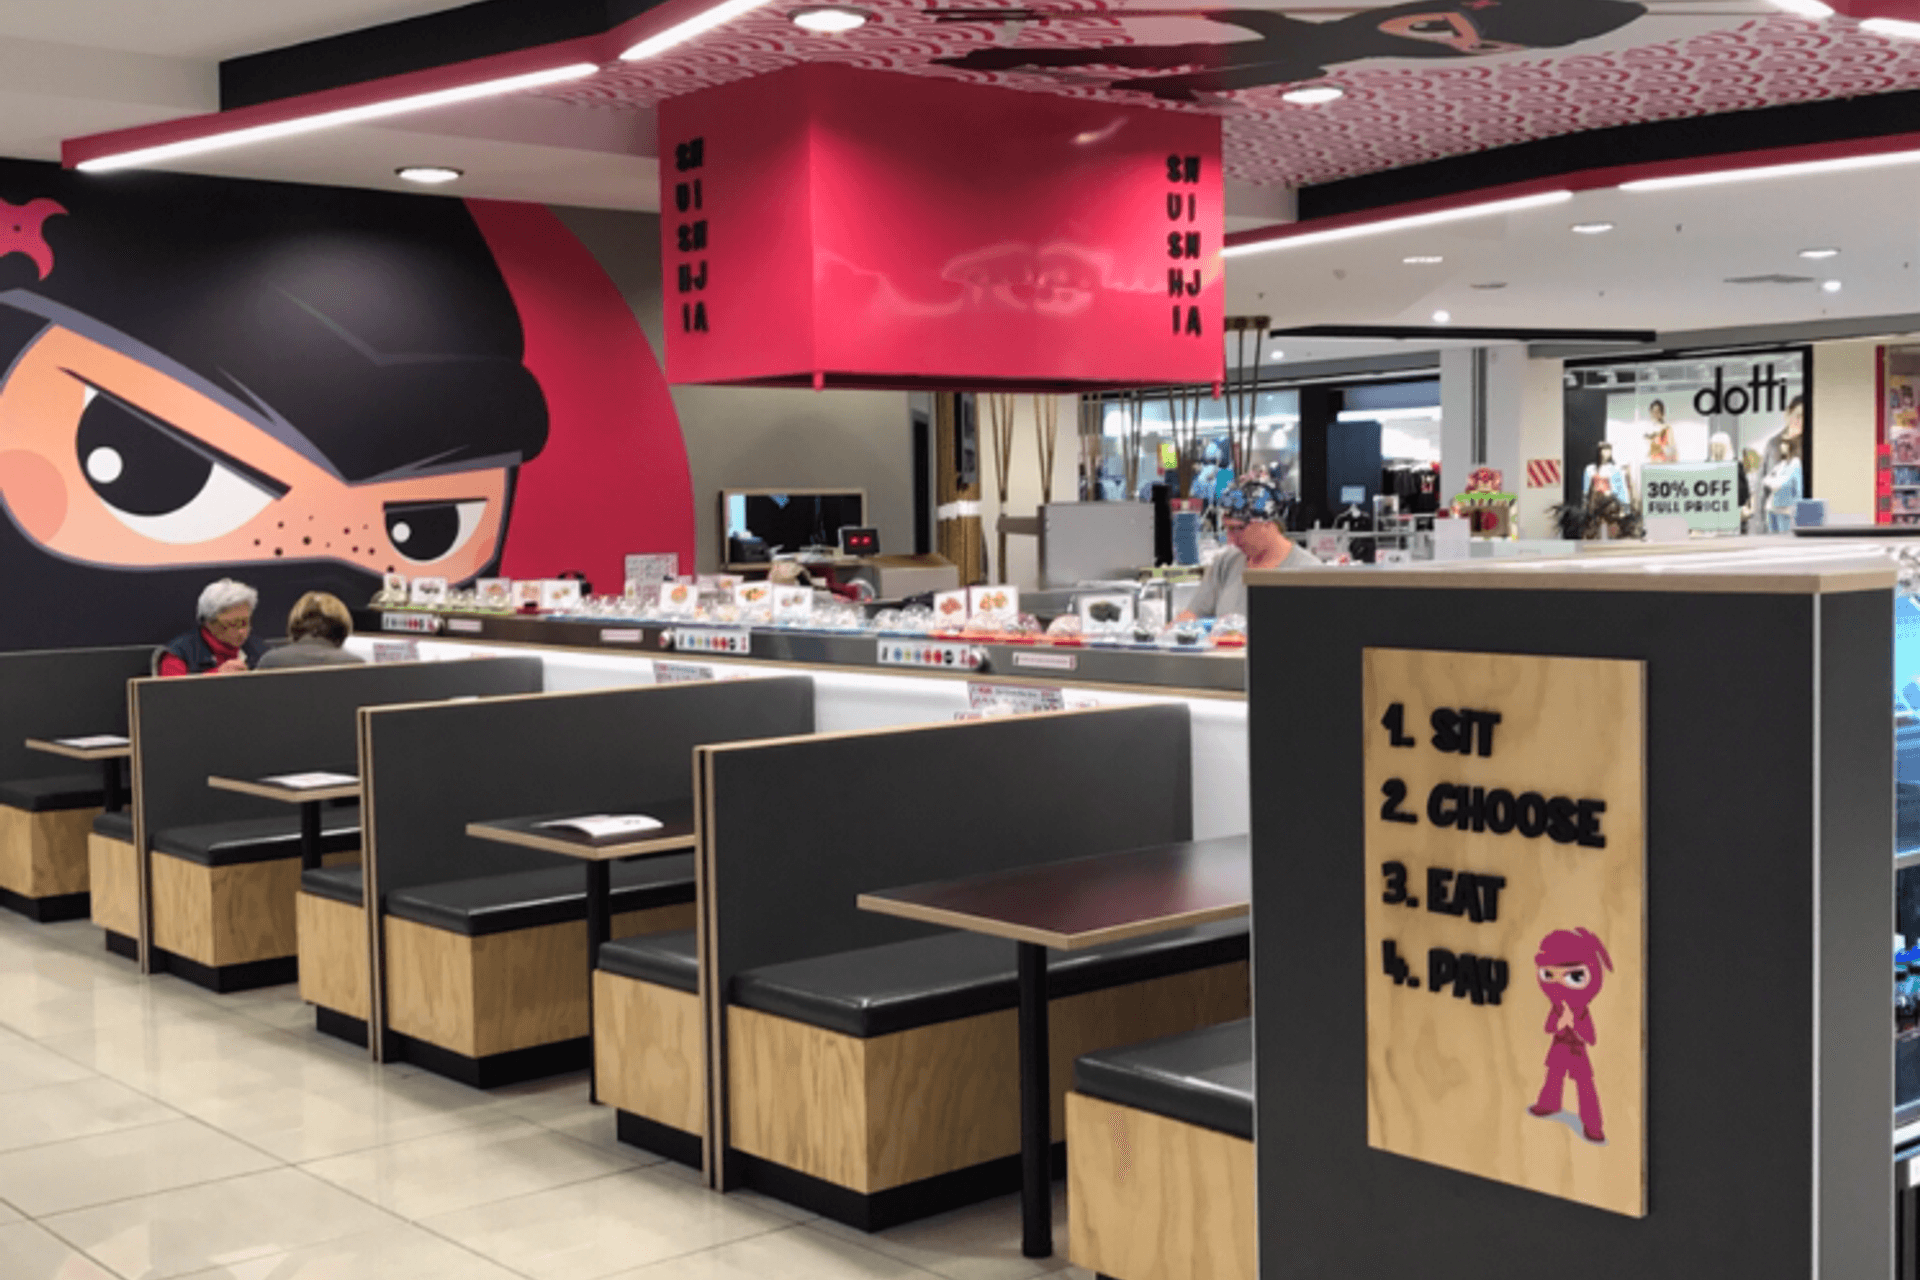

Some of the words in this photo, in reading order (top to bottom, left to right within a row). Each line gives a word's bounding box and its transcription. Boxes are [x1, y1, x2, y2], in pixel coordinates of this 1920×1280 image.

[1166, 154, 1183, 336] SUSHI
[1183, 154, 1202, 338] NINJA
[1693, 363, 1787, 416] dotti
[1648, 481, 1689, 498] 30%
[1693, 480, 1732, 497] OFF
[1648, 501, 1680, 513] FULL
[1684, 500, 1730, 513] PRICE
[1430, 708, 1502, 758] SIT
[1380, 778, 1418, 824] 2.
[1426, 782, 1606, 849] CHOOSE
[1381, 861, 1419, 908] 3.
[1426, 867, 1506, 923] EAT
[1381, 939, 1420, 988] 4.
[1427, 948, 1509, 1006] PAY
